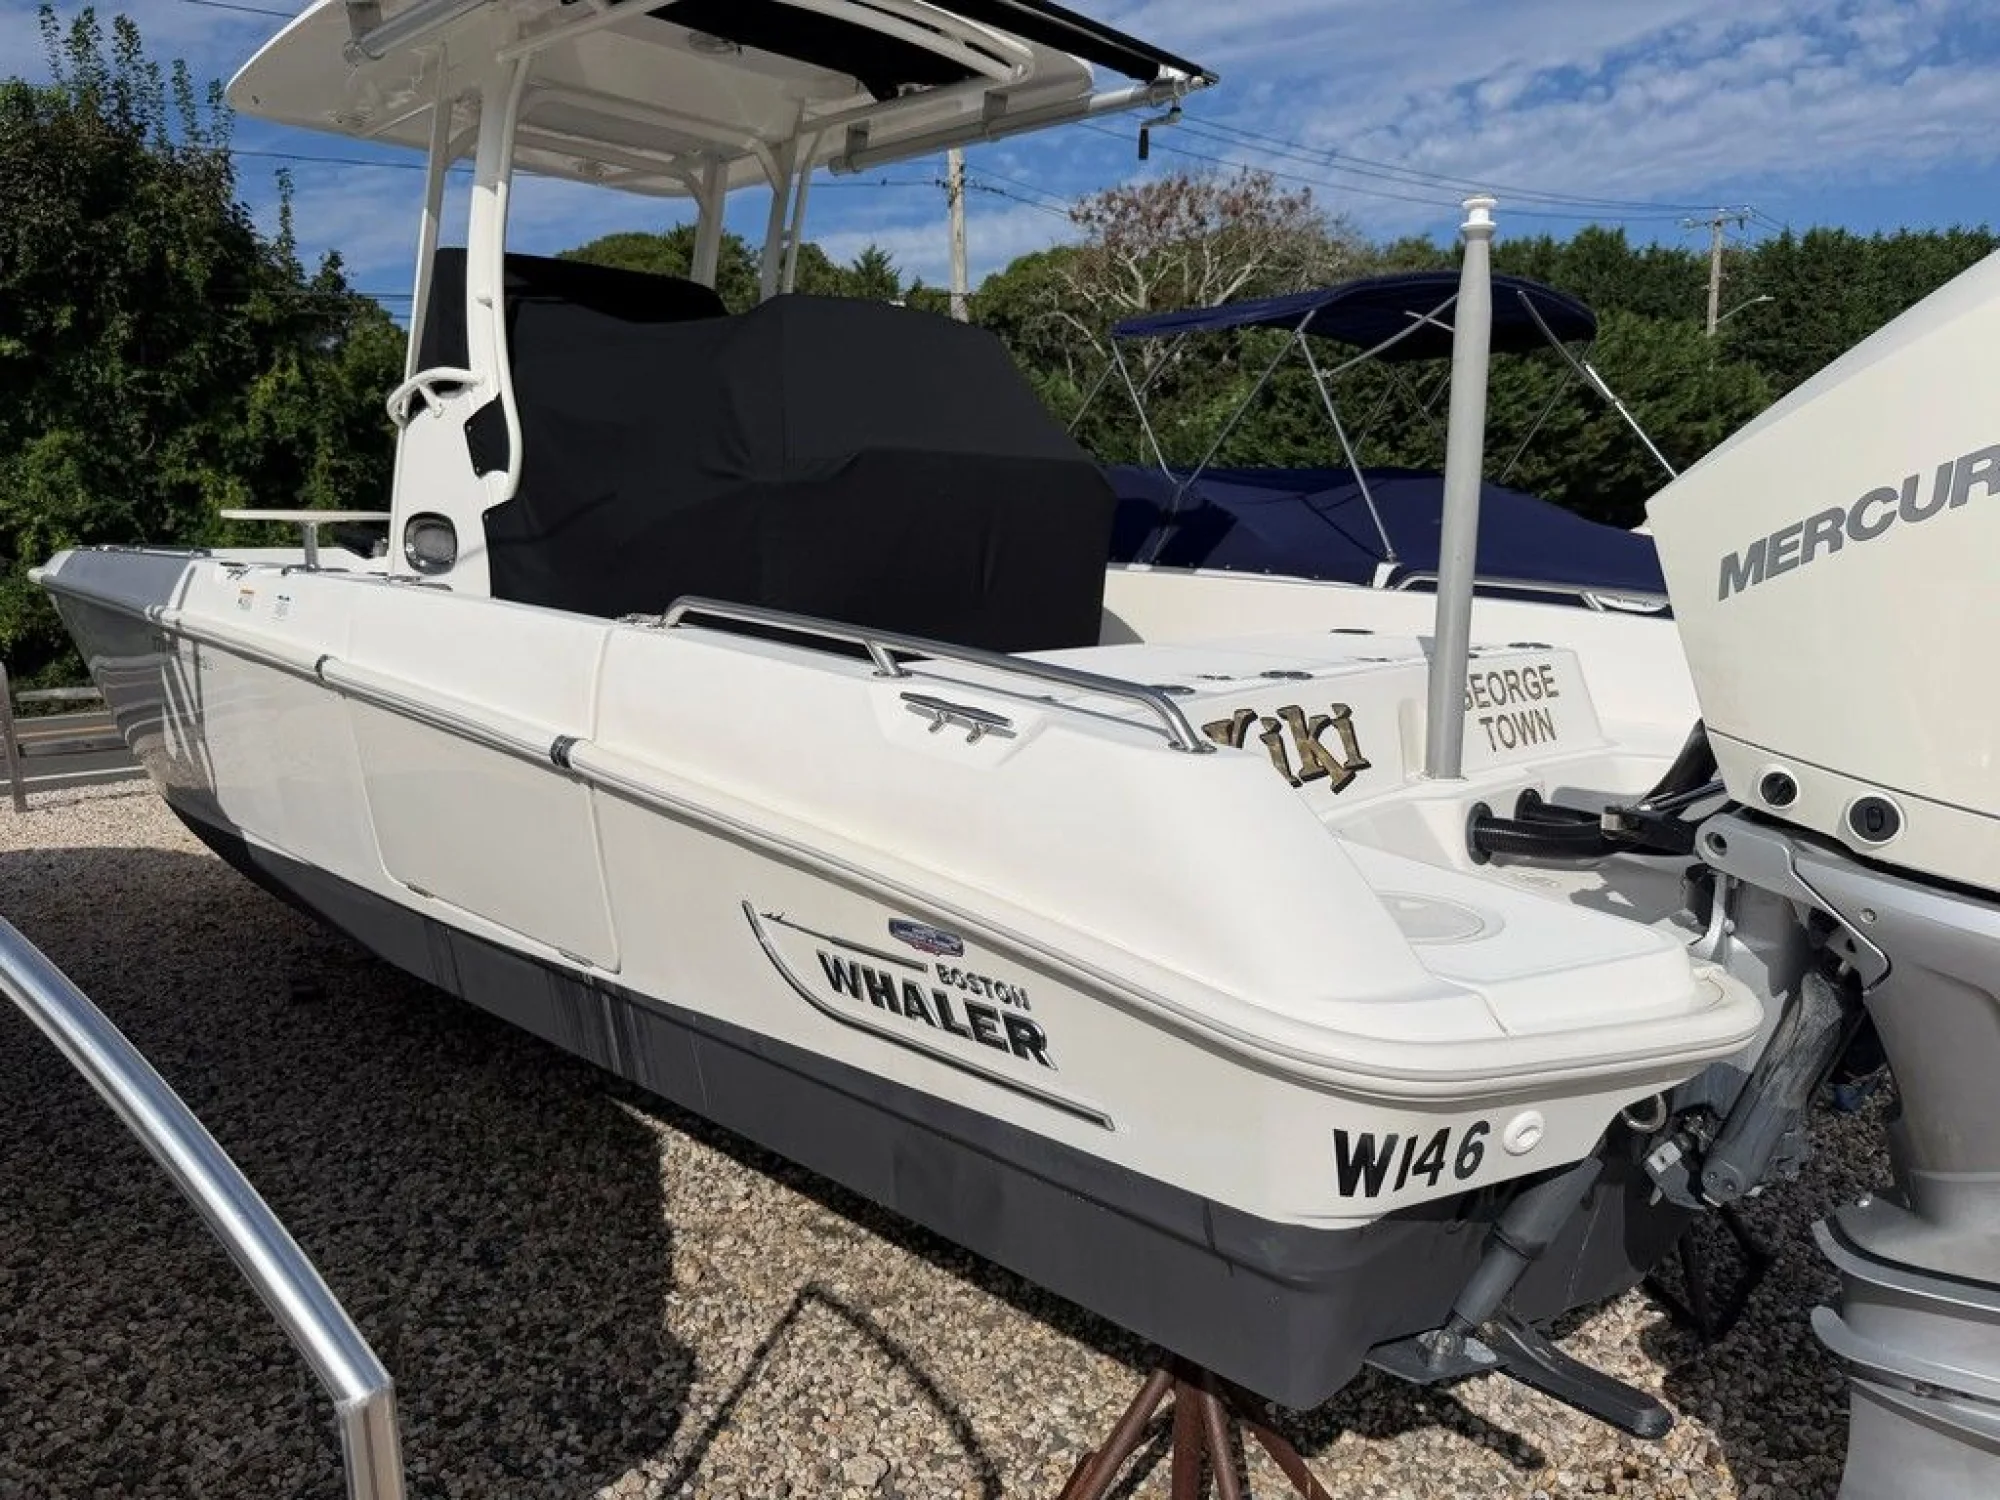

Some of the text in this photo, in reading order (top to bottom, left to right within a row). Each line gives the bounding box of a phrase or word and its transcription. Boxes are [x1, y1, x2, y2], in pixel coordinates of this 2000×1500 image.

[1718, 444, 2000, 601] MERCUR
[1479, 707, 1557, 752] TOWN
[817, 950, 1058, 1071] WHALER
[936, 963, 1031, 1011] BOSTON
[1333, 1120, 1490, 1197] W146
